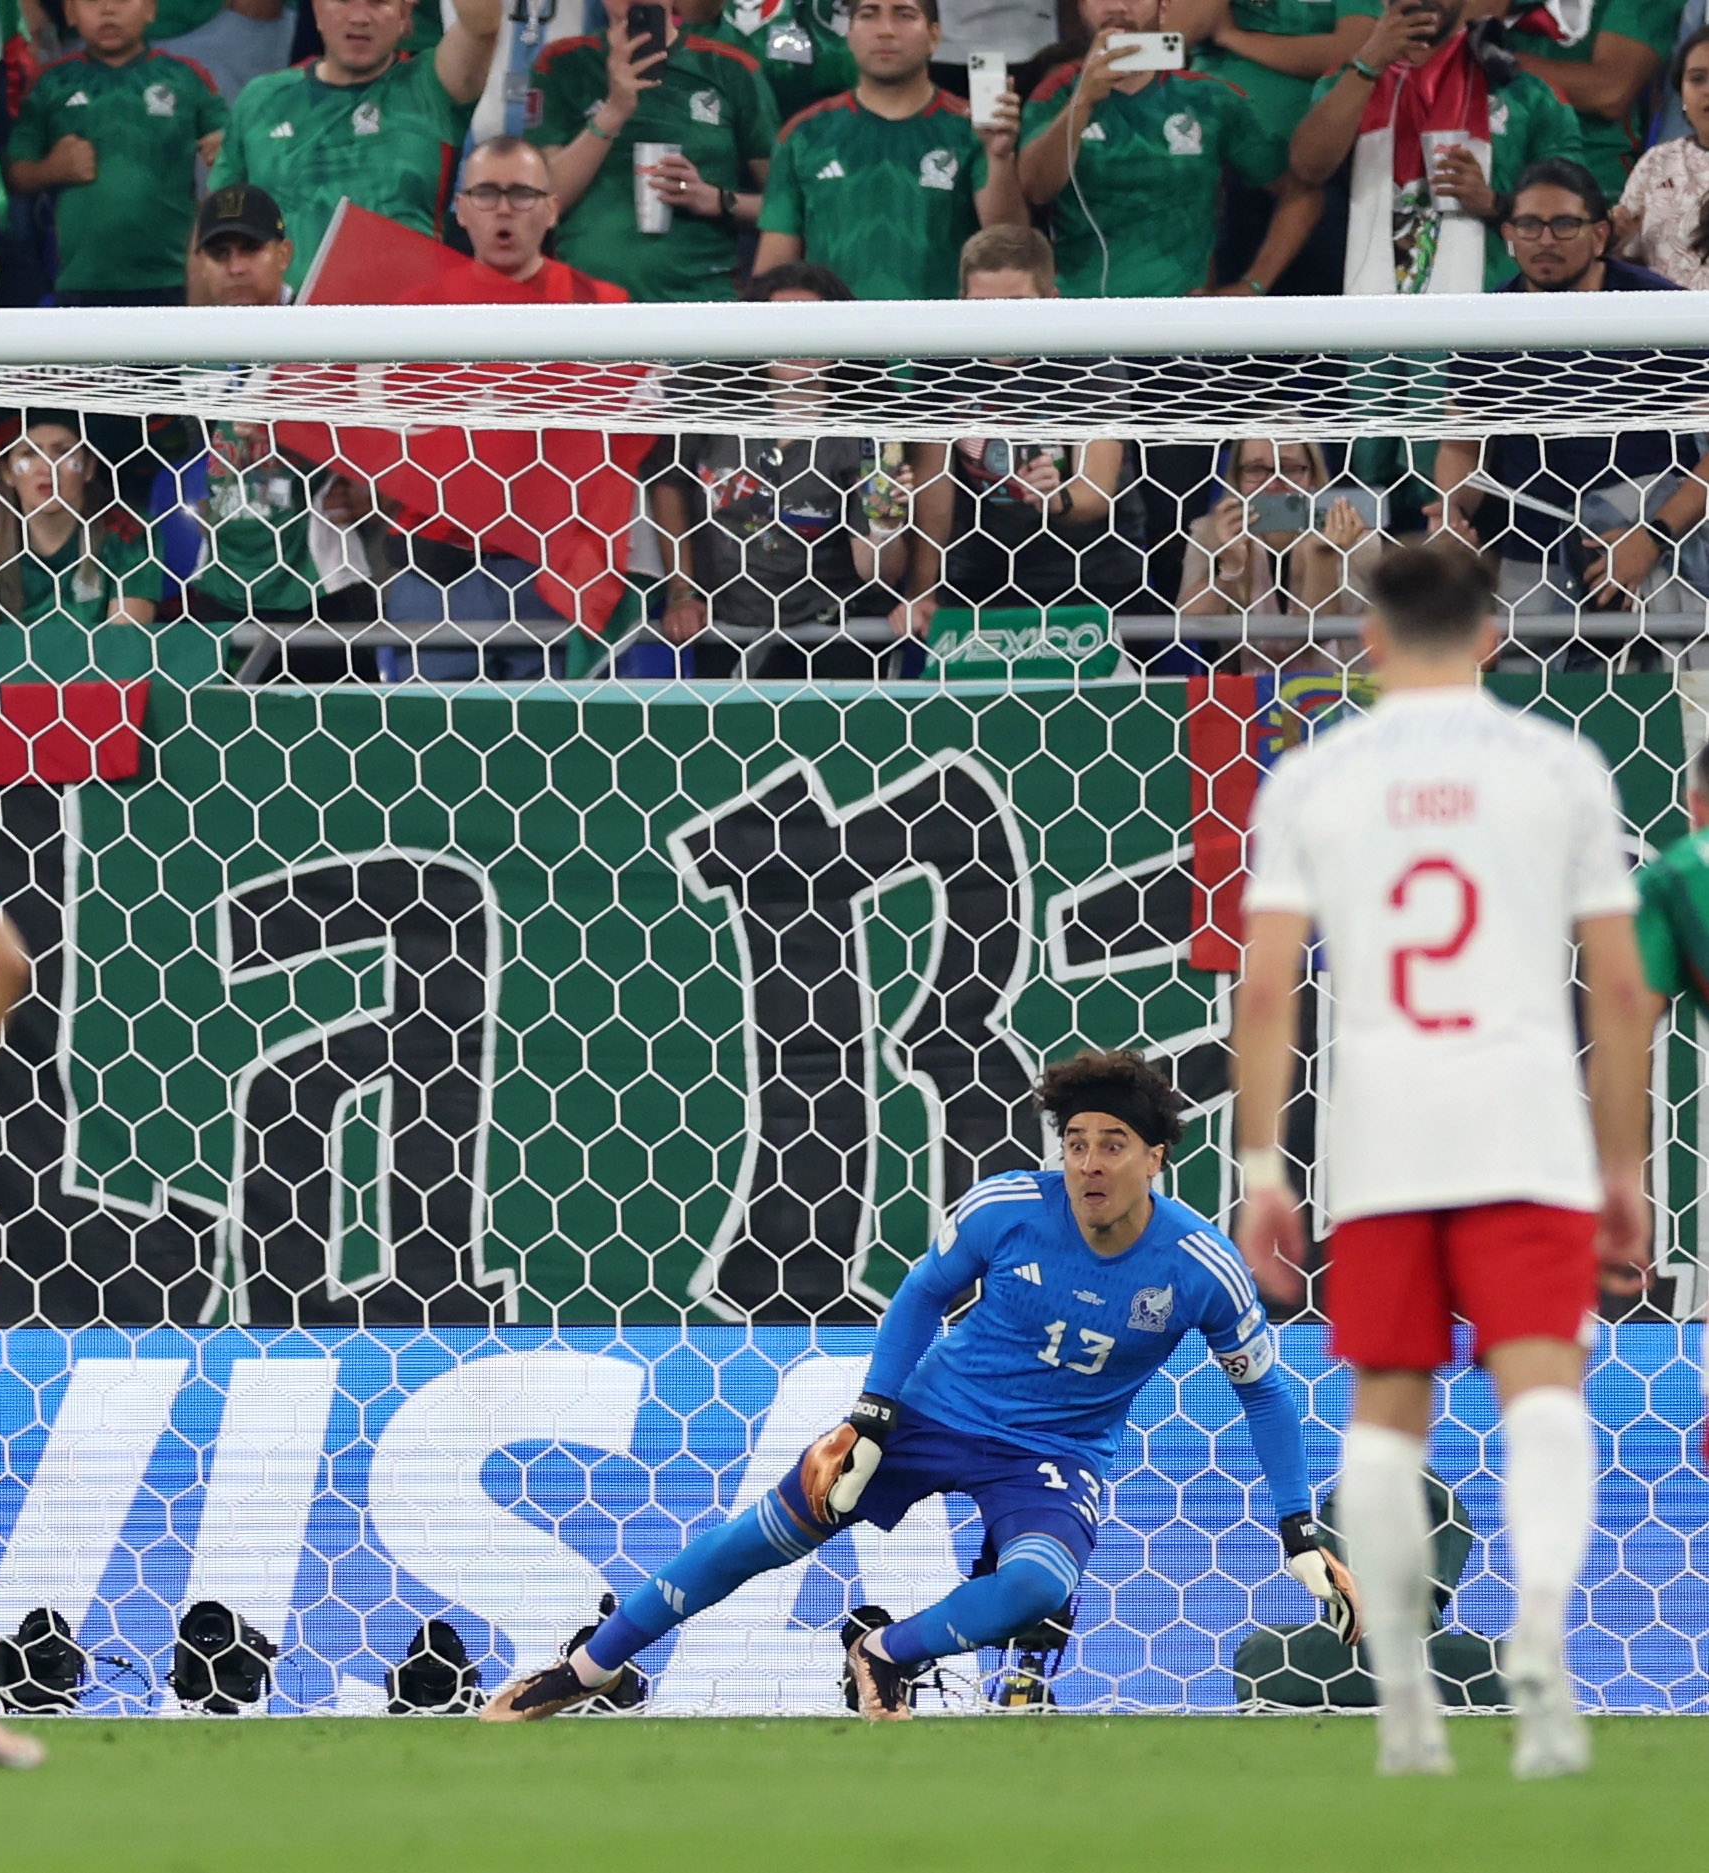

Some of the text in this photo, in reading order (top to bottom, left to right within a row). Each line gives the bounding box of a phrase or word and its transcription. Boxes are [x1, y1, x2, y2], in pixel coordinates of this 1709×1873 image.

[926, 622, 1104, 668] MEXICO
[1388, 854, 1479, 1032] 2
[1037, 1319, 1116, 1376] 13
